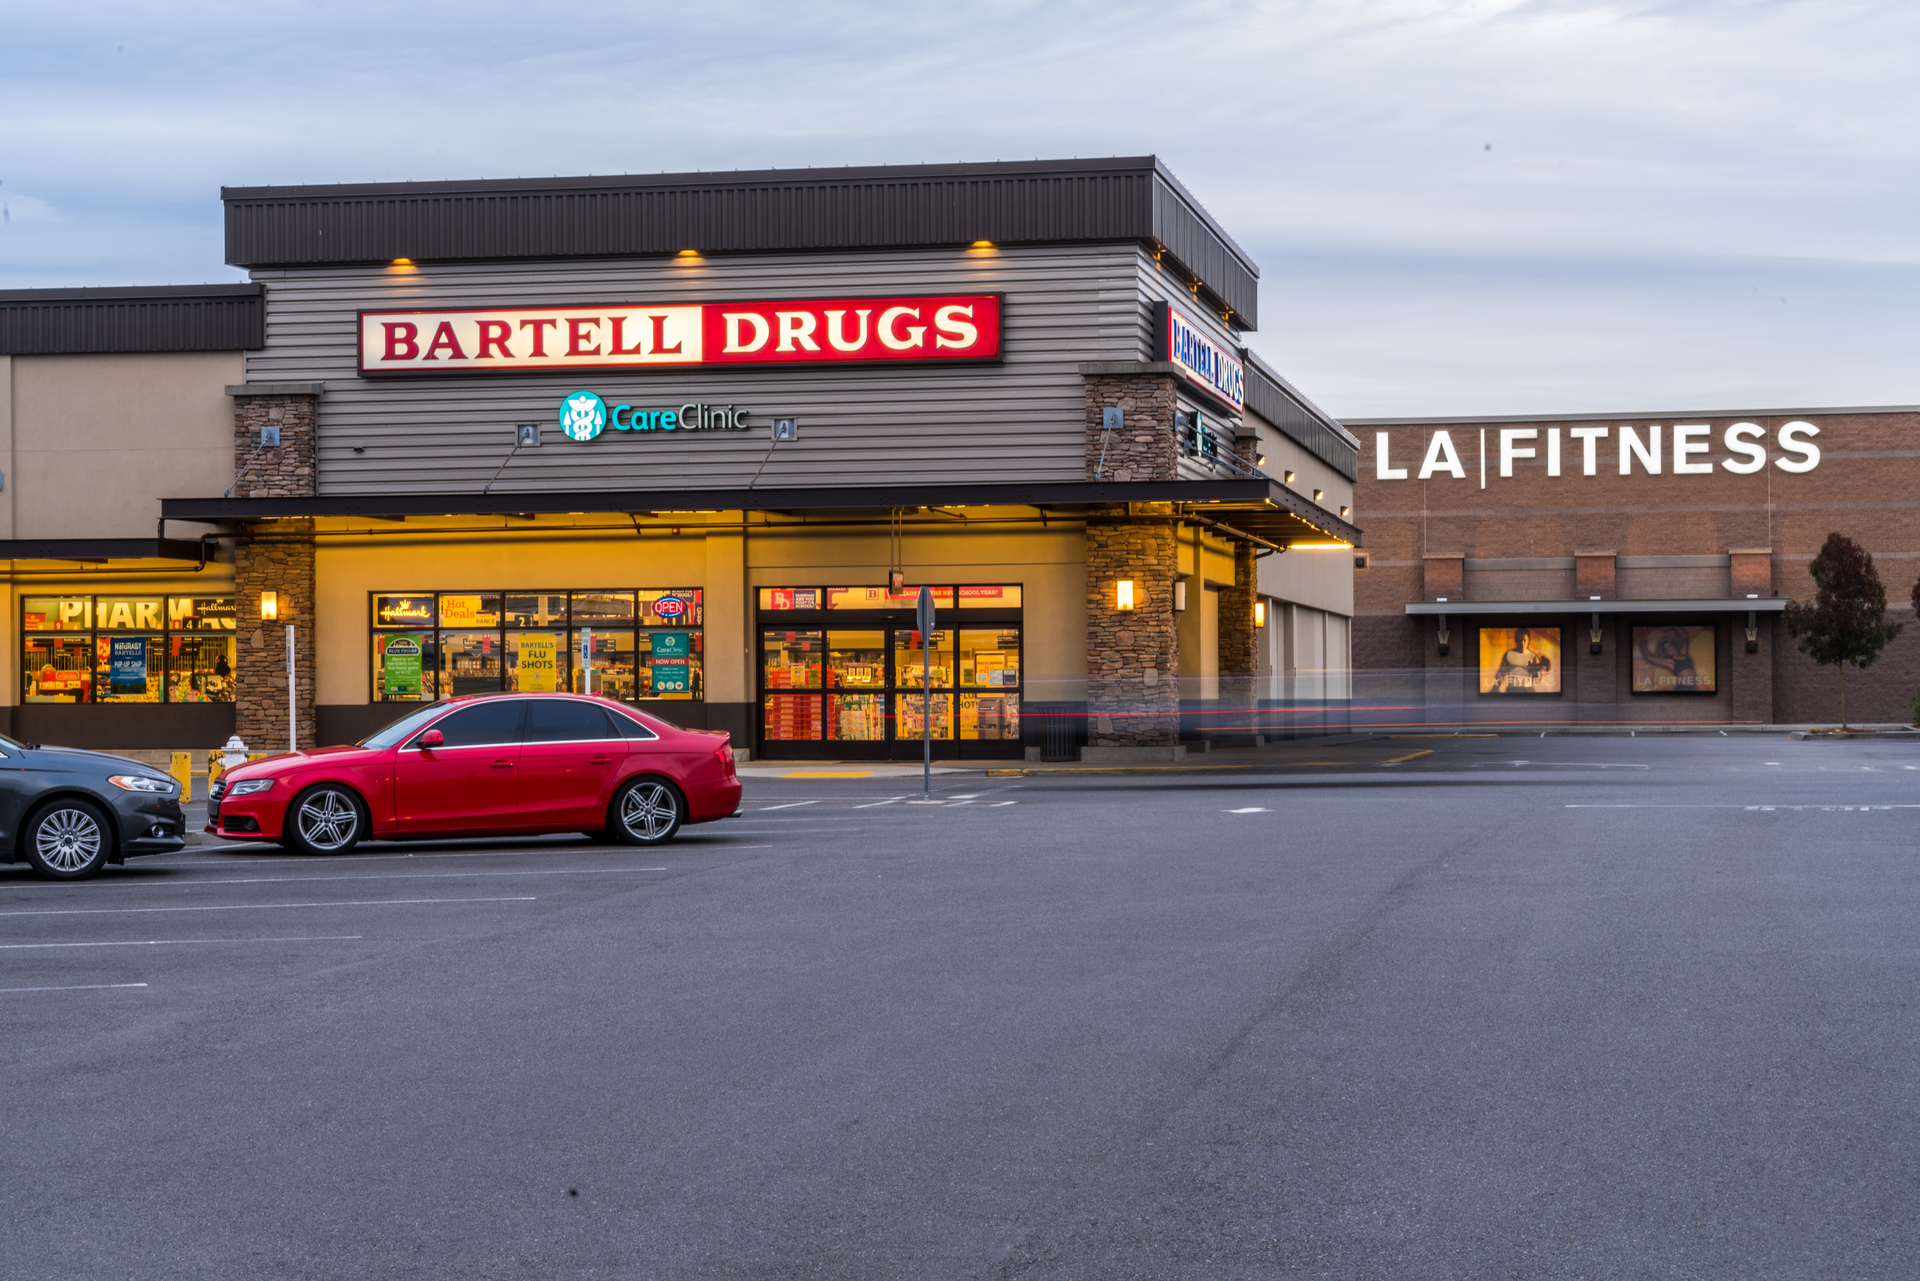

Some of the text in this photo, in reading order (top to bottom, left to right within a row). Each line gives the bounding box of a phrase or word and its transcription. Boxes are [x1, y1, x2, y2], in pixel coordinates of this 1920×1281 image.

[380, 304, 979, 361] BARTELL DRUGS
[1173, 319, 1244, 405] BARTELL DRUGS
[612, 403, 748, 431] CareClinic
[1376, 421, 1821, 480] LA FITNESS
[447, 600, 466, 609] Hot
[654, 601, 684, 613] OPEN
[60, 599, 236, 629] PHARM
[380, 605, 430, 621] Hallmark
[445, 608, 476, 619] Deals
[528, 650, 546, 659] FLU
[521, 660, 553, 669] SHOTS
[1484, 676, 1557, 687] LA FITNESS
[1637, 675, 1711, 686] LA FITNESS
